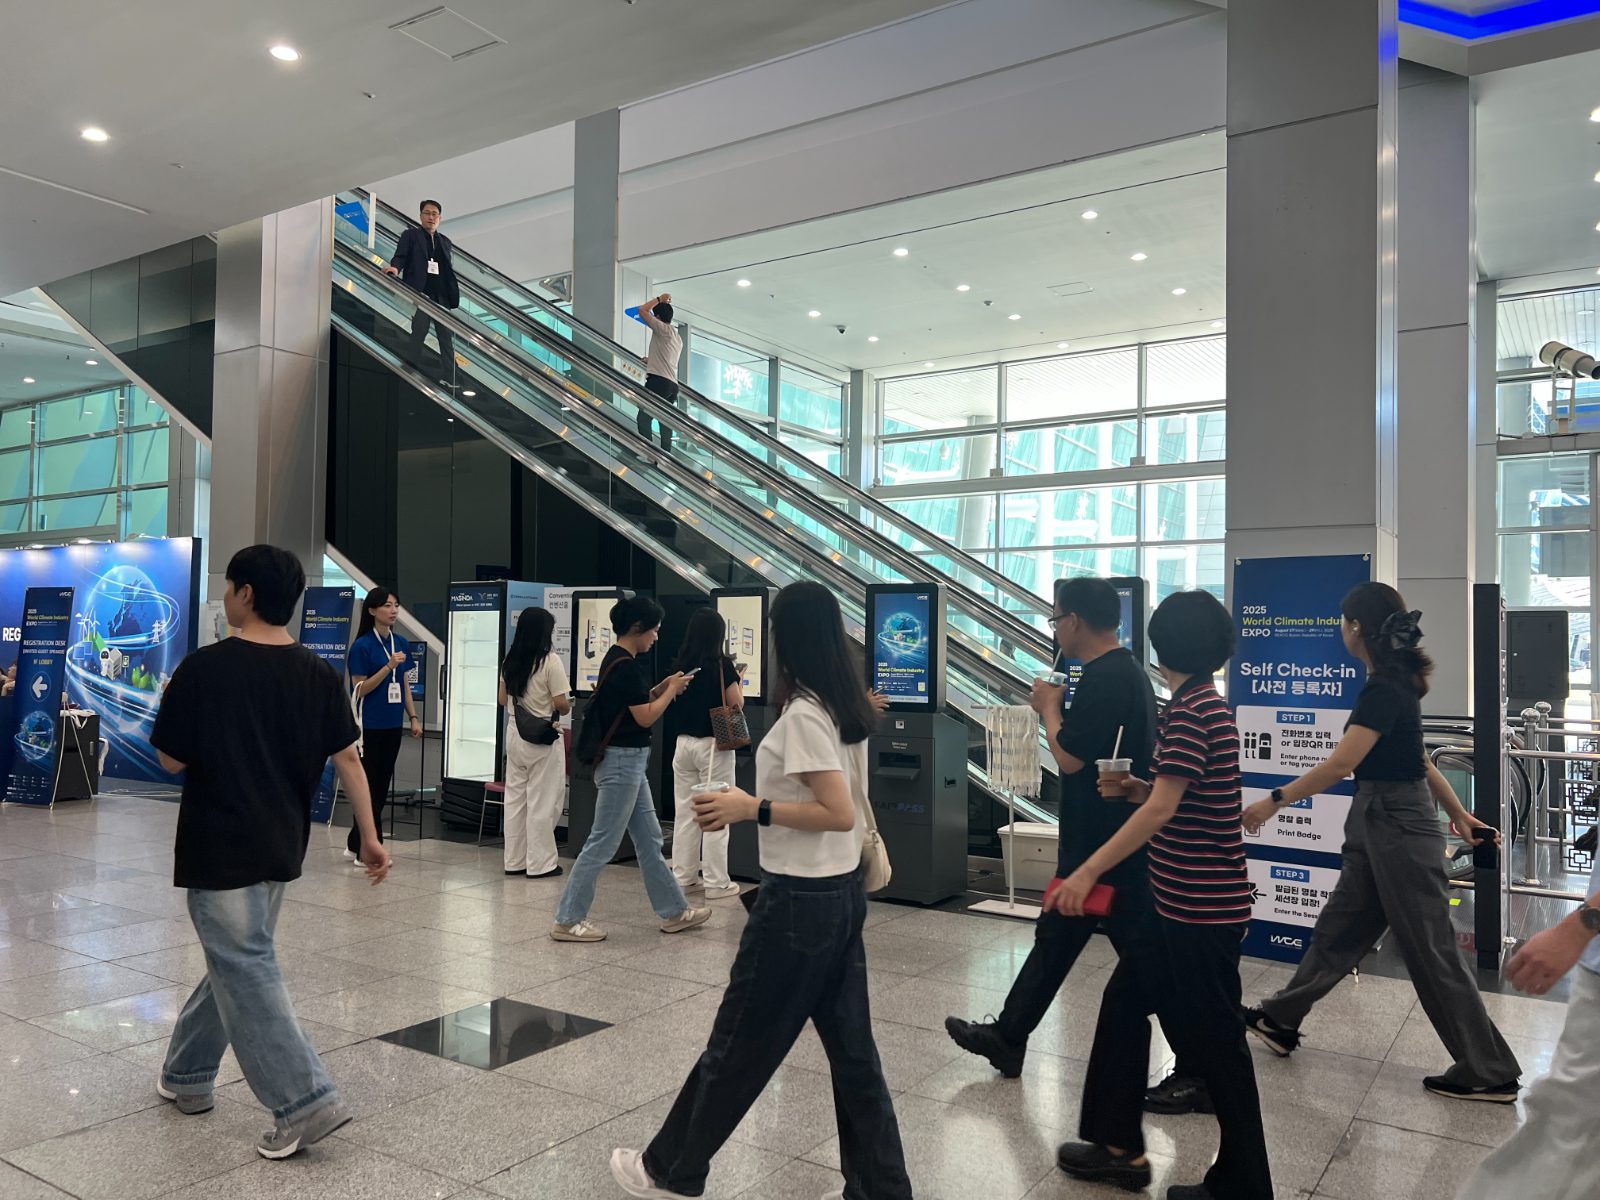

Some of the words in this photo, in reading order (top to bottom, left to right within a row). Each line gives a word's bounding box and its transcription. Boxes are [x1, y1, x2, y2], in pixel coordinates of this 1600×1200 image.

[1242, 606, 1267, 614] 2025
[1242, 617, 1272, 626] World
[1274, 617, 1314, 626] Climate
[1242, 628, 1270, 637] EXPO
[1240, 663, 1273, 676] Self
[1277, 663, 1356, 678] Check-in
[1252, 680, 1286, 695] [사전
[1291, 682, 1342, 696] 등록자]
[1282, 730, 1312, 738] 전화번호
[1316, 731, 1331, 739] 입력
[1278, 814, 1293, 823] 명찰
[1278, 829, 1295, 837] Print
[1297, 831, 1321, 840] Badge
[1275, 869, 1297, 878] STEP
